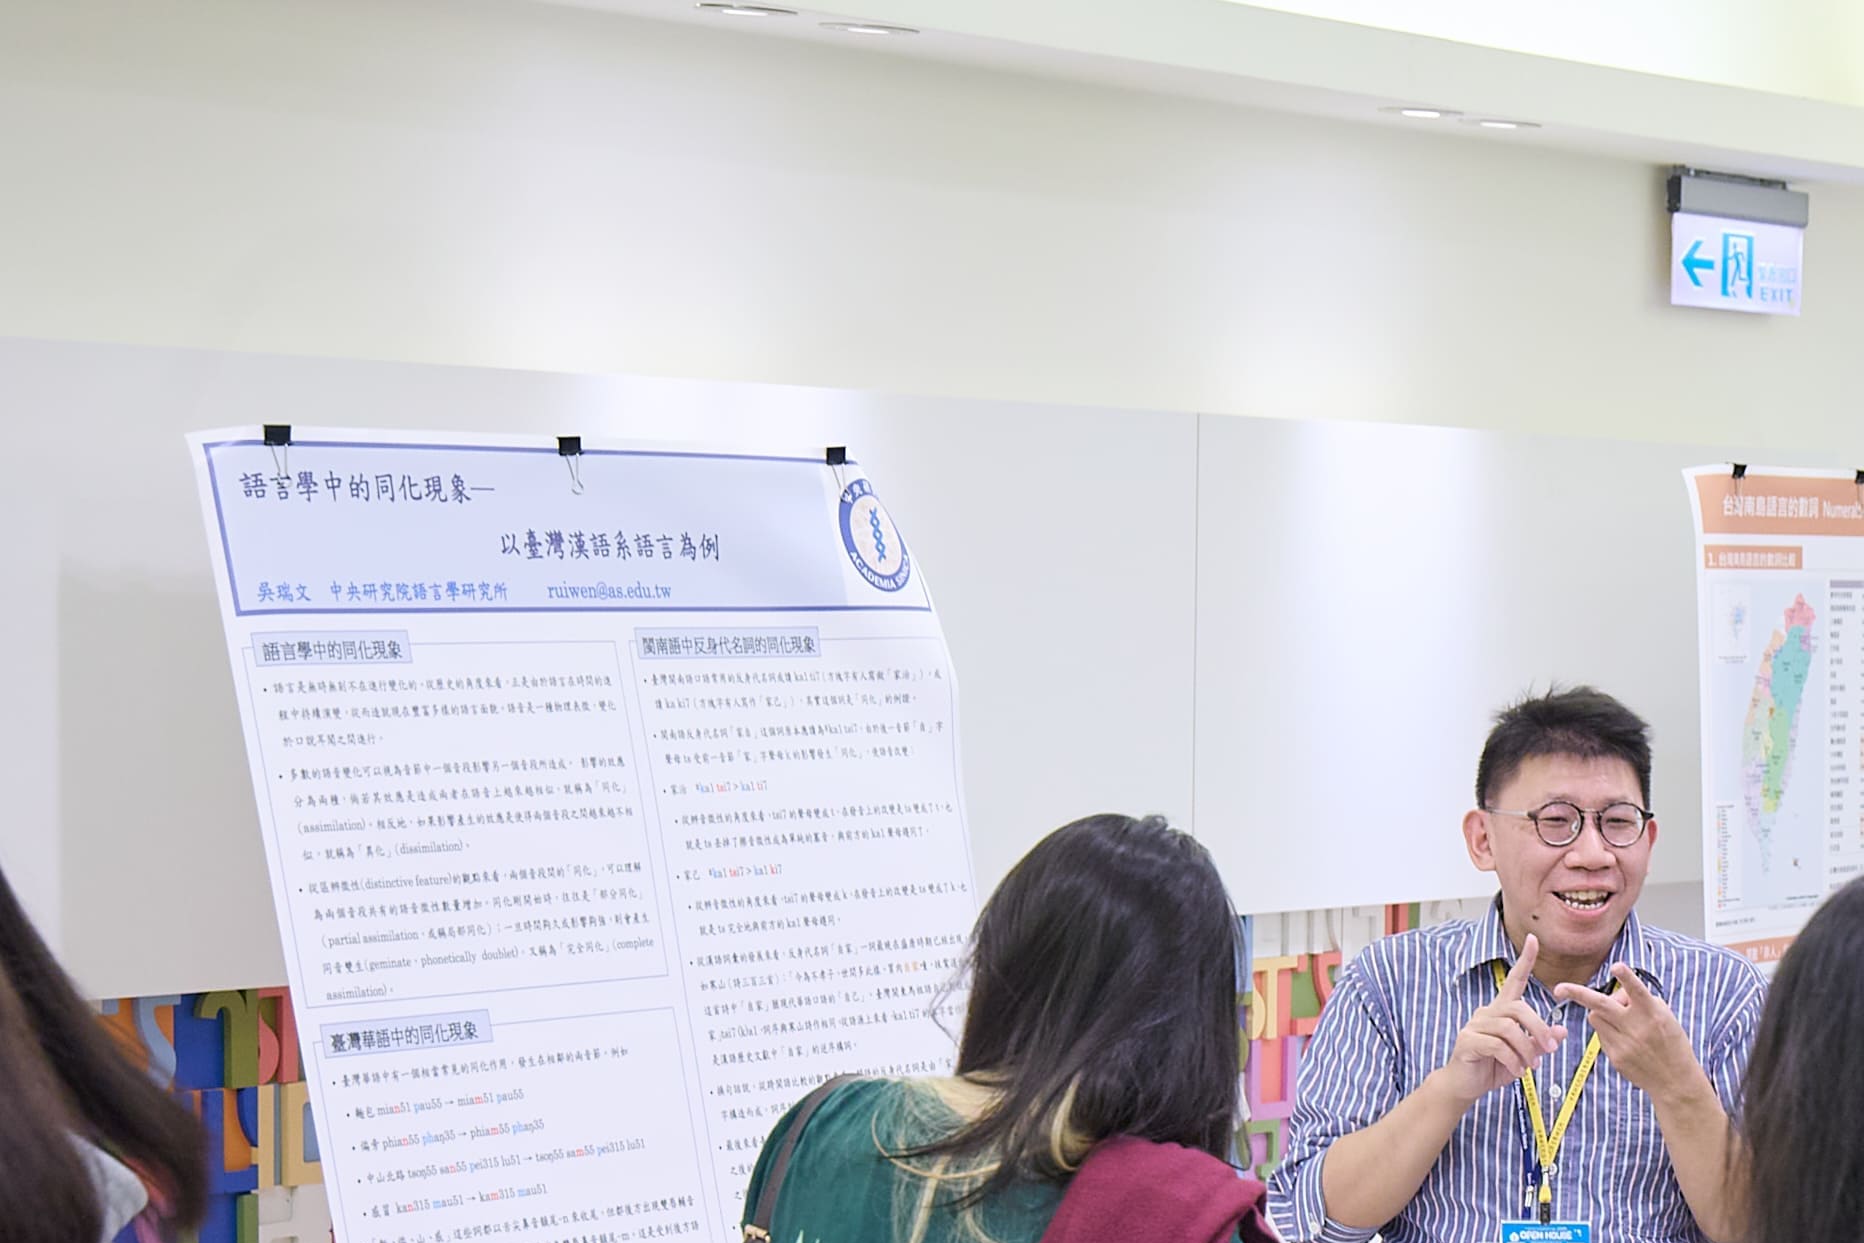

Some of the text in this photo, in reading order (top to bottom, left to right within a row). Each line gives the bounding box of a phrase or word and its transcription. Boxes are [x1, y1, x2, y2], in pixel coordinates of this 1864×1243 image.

[1760, 287, 1793, 302] EXIT
[500, 528, 719, 561] 以臺灣漢語系語言為例
[257, 579, 672, 602] 吳瑞文 中央研究院語言學研究所 ruiwen@as.edu.tw
[262, 639, 403, 662] 語言學中的同化現象
[642, 636, 815, 655] 閩南語中反身代名詞的同化現象
[331, 1021, 479, 1053] 臺灣華語中的同化現象
[414, 1098, 442, 1115] pau55
[496, 1088, 524, 1104] pau55
